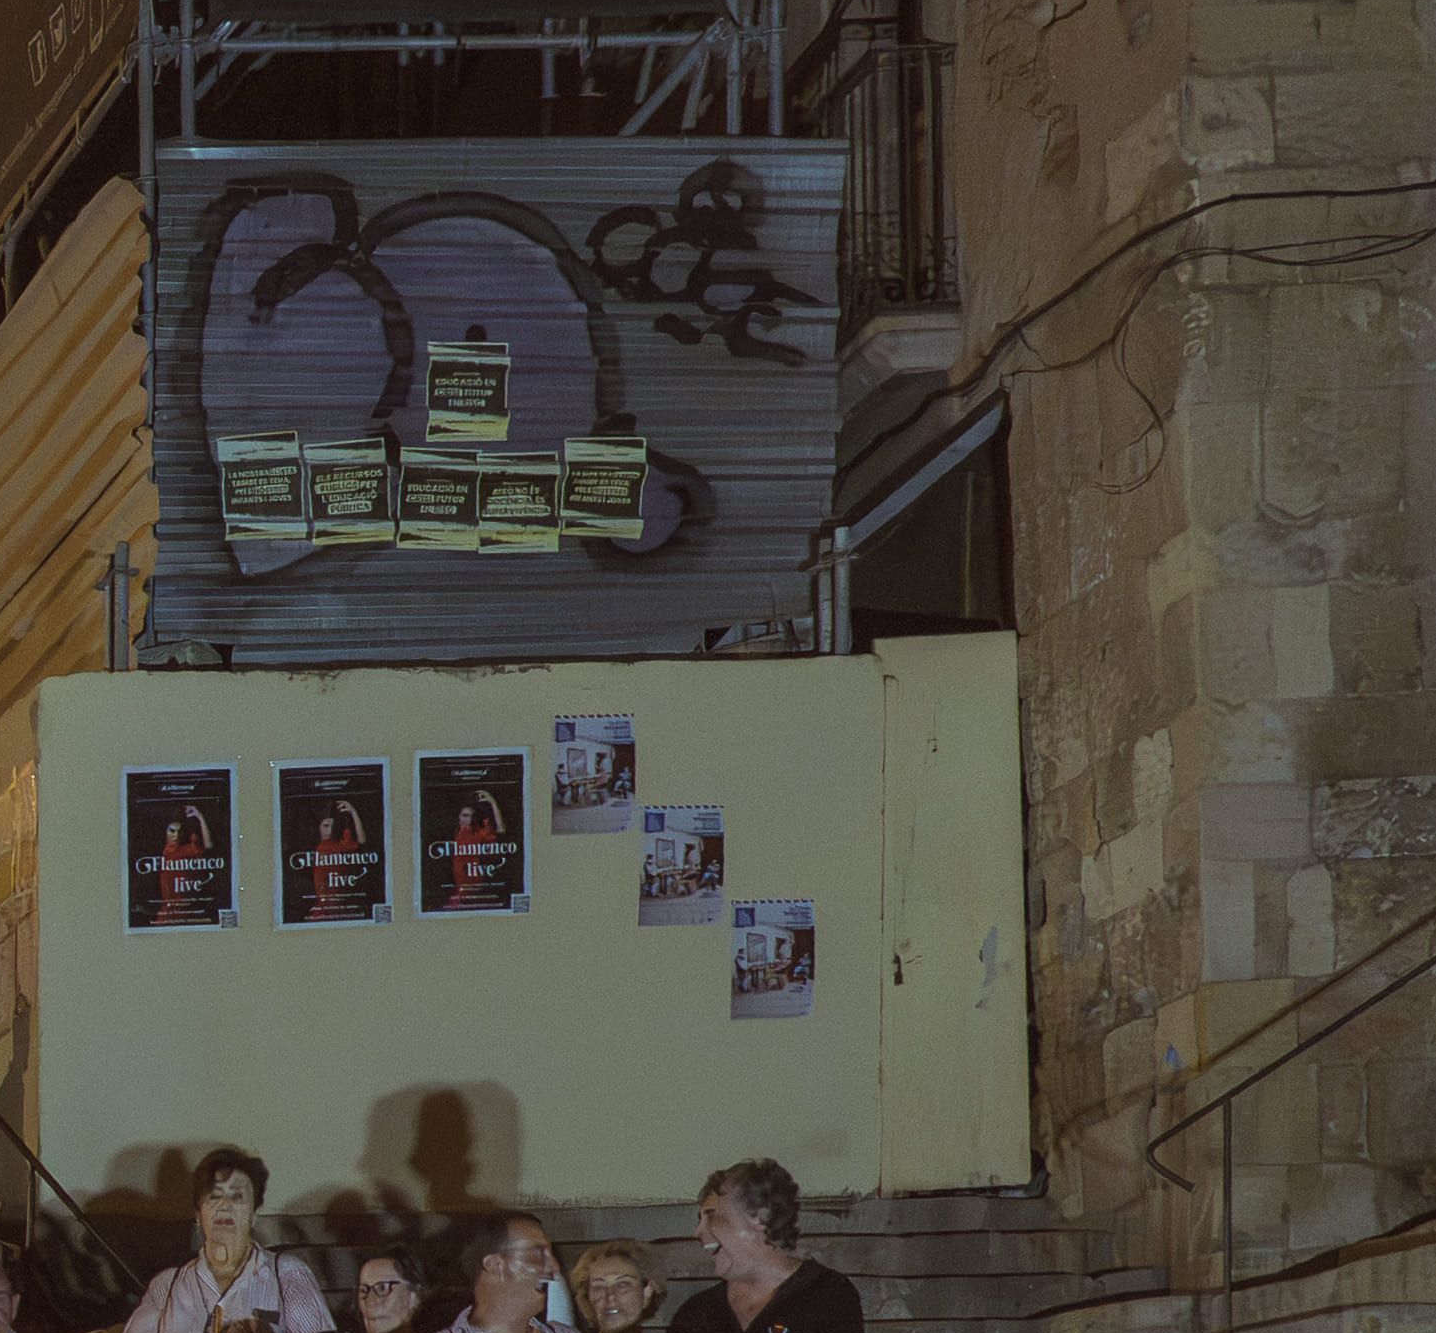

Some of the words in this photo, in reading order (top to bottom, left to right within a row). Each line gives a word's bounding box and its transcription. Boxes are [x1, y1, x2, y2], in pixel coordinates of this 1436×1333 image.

[289, 850, 379, 871] Flamenco
[428, 840, 517, 860] Flamenco
[135, 854, 225, 875] Flamenco
[467, 856, 507, 879] live
[173, 872, 215, 894] live
[328, 866, 368, 888] live
